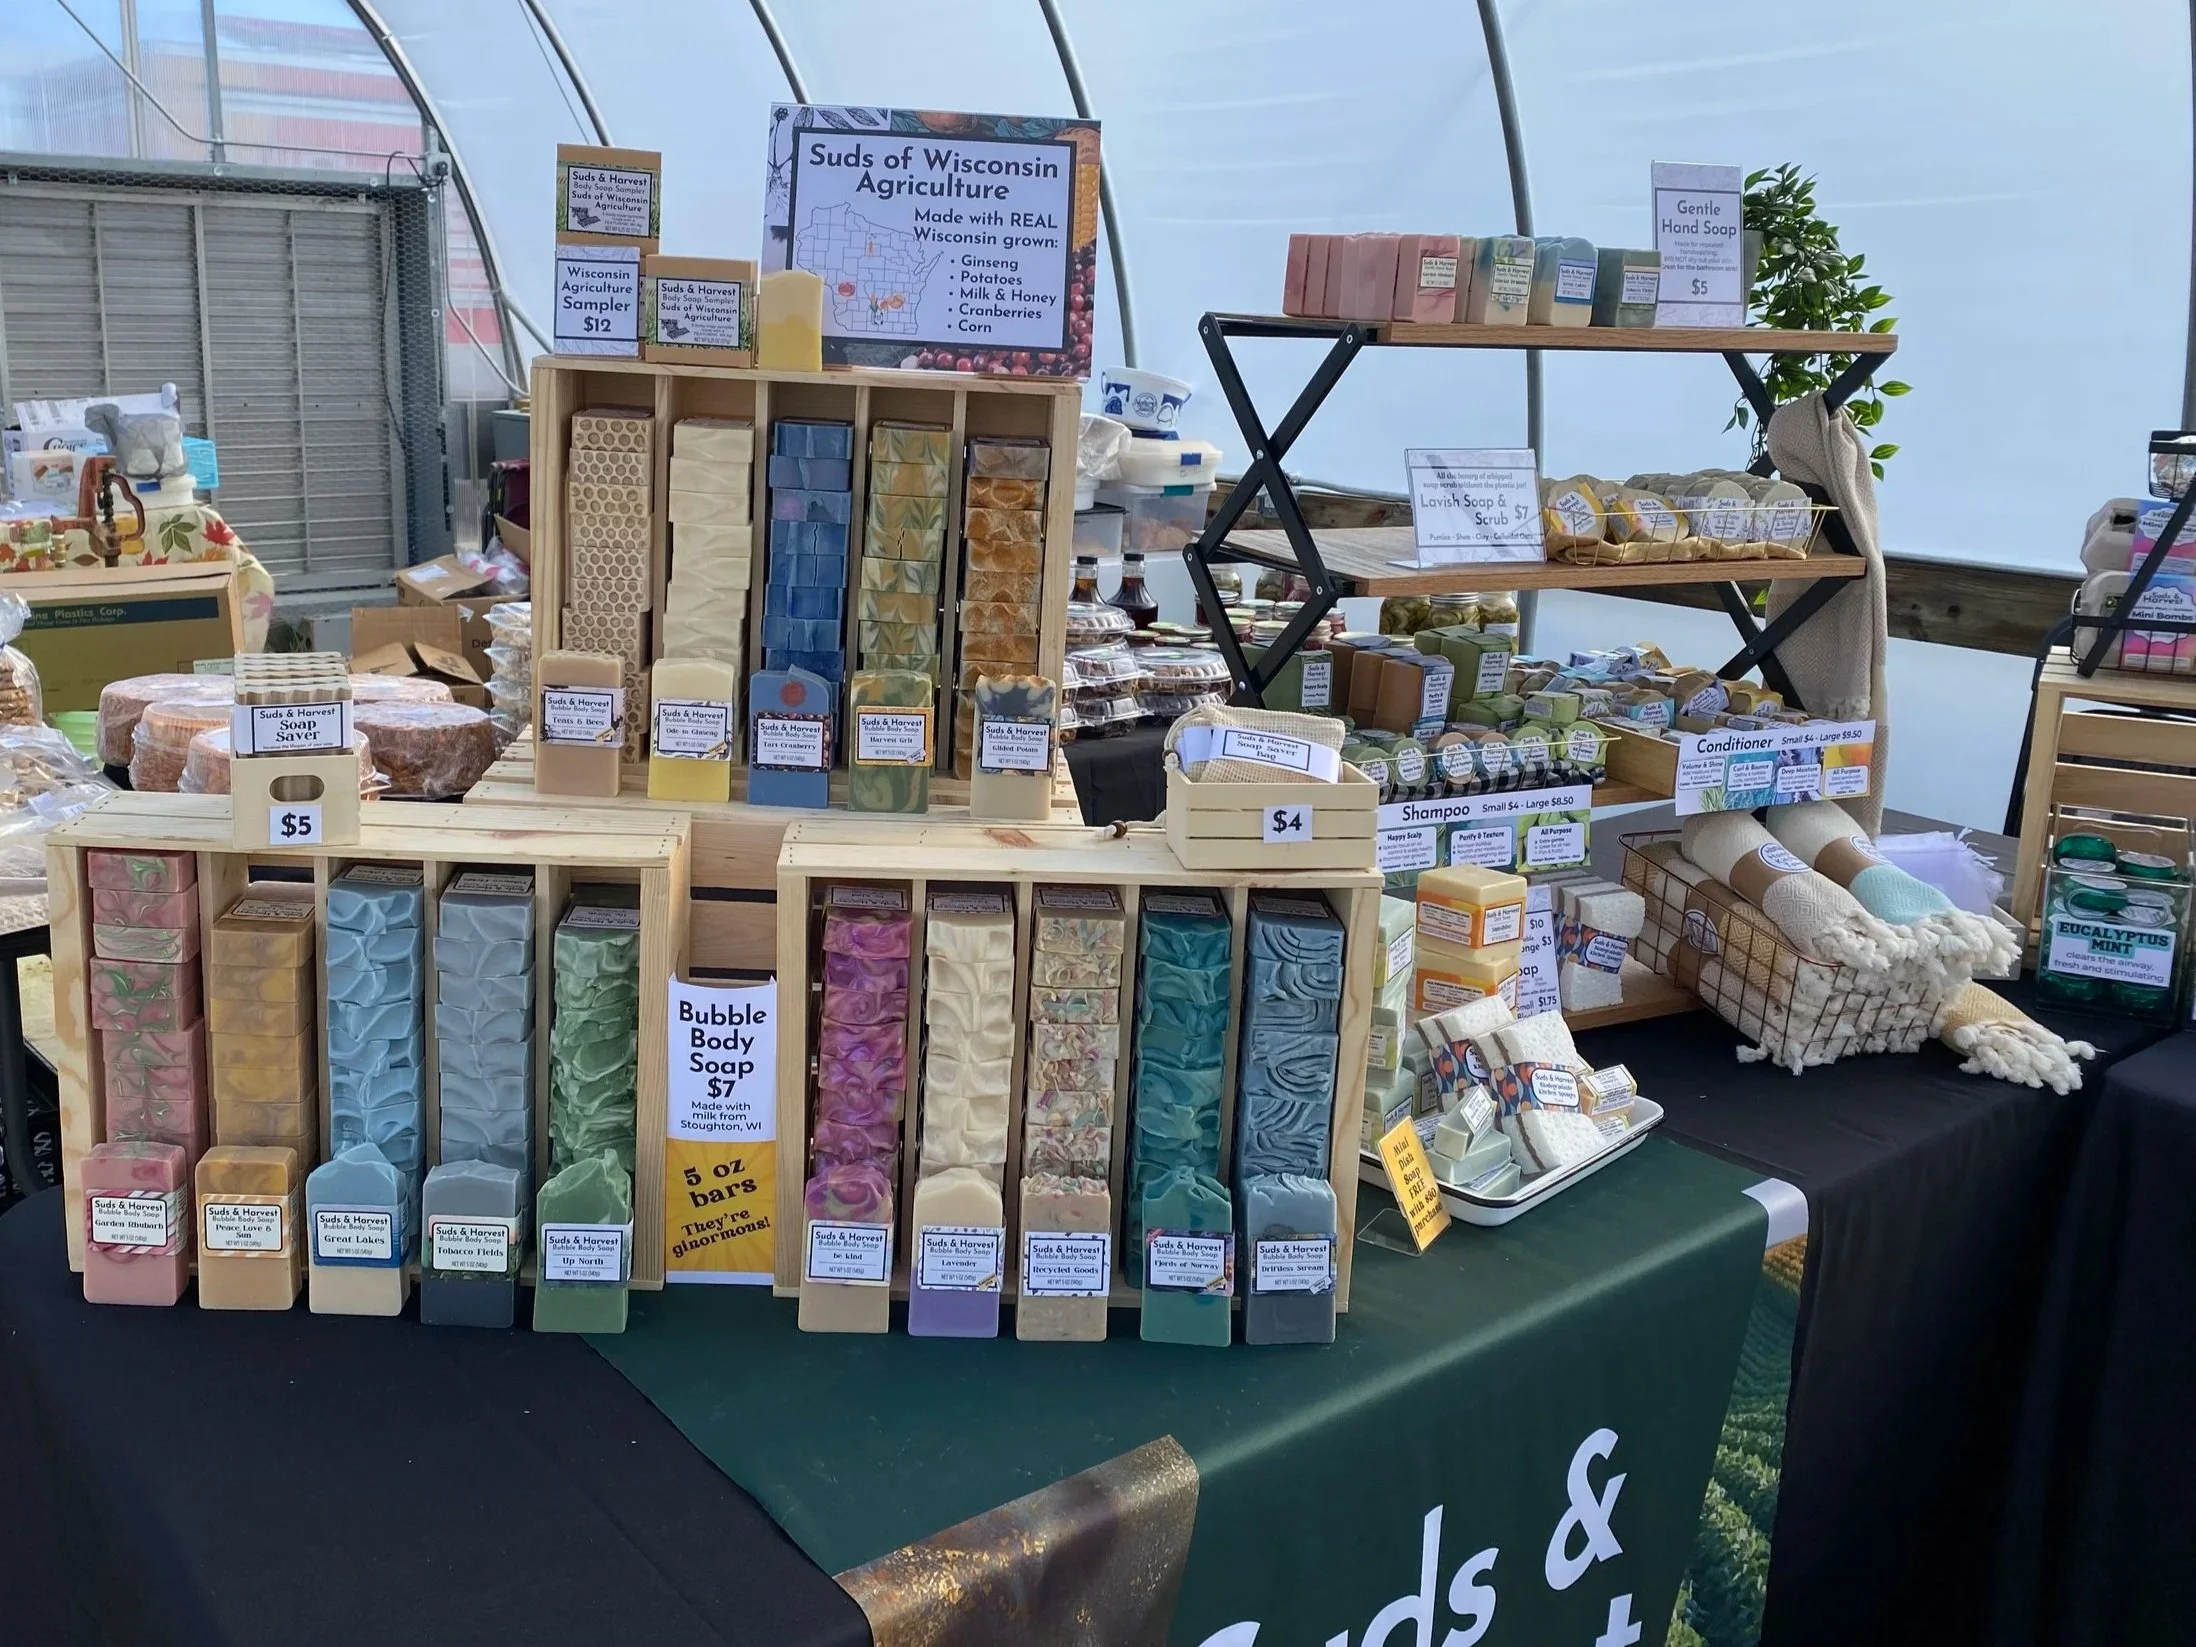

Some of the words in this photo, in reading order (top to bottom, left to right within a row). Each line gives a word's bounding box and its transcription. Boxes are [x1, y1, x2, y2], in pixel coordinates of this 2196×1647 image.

[810, 143, 874, 169] Suds
[885, 145, 914, 169] of
[924, 148, 1058, 179] Wisconsin
[573, 171, 595, 183] Suds
[598, 174, 606, 183] &
[610, 175, 648, 187] Harvest
[856, 169, 1010, 200] Agriculture
[572, 190, 592, 200] Suds
[595, 192, 604, 201] of
[607, 194, 648, 205] Wisconsin
[595, 201, 642, 212] Agriculture
[1677, 200, 1721, 216] Gentle
[914, 207, 964, 225] Made
[970, 210, 1004, 227] with
[1010, 212, 1058, 229] REAL
[1662, 219, 1698, 235] Hand
[1703, 220, 1737, 239] Soap
[914, 226, 997, 246] Wisconsin
[1003, 235, 1058, 250] grown:
[961, 255, 1019, 272] Ginseng
[567, 266, 630, 280] Wisconsin
[961, 271, 1022, 286] Potatoes
[562, 281, 632, 294] Agriculture
[661, 283, 684, 293] Suds
[687, 285, 695, 294] &
[699, 285, 736, 297] Harvest
[1691, 277, 1709, 296] $5
[563, 296, 630, 314] Sampler
[960, 287, 990, 300] Milk
[996, 289, 1006, 301] &
[1011, 291, 1057, 307] Honey
[661, 303, 680, 312] Suds
[684, 303, 693, 312] of
[696, 305, 737, 315] Wisconsin
[960, 303, 1042, 320] Cranberries
[584, 315, 611, 333] $12
[684, 313, 732, 325] Agriculture
[958, 320, 992, 333] Corn
[1420, 493, 1460, 508] Lavish
[1464, 494, 1494, 510] Soap
[1498, 494, 1507, 507] &
[1476, 511, 1509, 525] Scrub
[1514, 504, 1529, 521] $7
[55, 609, 94, 619] Plastics
[100, 607, 127, 617] Corp.
[2132, 610, 2154, 619] Mini
[2156, 612, 2193, 620] Bombs
[260, 710, 283, 719] Suds
[286, 709, 294, 717] &
[298, 707, 335, 717] Harvest
[552, 717, 573, 725] Teats
[280, 719, 316, 732] Soap
[691, 729, 718, 738] Ginseng
[275, 731, 320, 743] Saver
[1697, 736, 1773, 754] Conditioner
[1782, 735, 1803, 745] Small
[1804, 735, 1814, 744] $4
[1820, 732, 1842, 742] Large
[1842, 730, 1862, 740] $9.50
[781, 742, 817, 752] Cranberry
[992, 745, 1015, 753] Gilded
[1237, 740, 1262, 751] Soap
[1266, 745, 1298, 757] Saver
[1257, 751, 1277, 761] Bag
[1782, 767, 1794, 775] Deep
[1402, 804, 1470, 822] Shampoo
[1482, 802, 1507, 813] Small
[1507, 800, 1519, 811] $4
[1526, 800, 1550, 810] Large
[1551, 796, 1574, 806] $8.50
[281, 812, 312, 838] $5
[1273, 810, 1303, 833] $4
[1387, 833, 1408, 843] Happy
[1410, 831, 1422, 840] Scalp
[1459, 832, 1476, 841] Purify
[1483, 831, 1505, 839] Texture
[1541, 828, 1551, 836] All
[1552, 827, 1573, 836] Purpose
[1530, 919, 1544, 930] $10
[1542, 936, 1552, 946] $3
[2058, 922, 2169, 948] EUCALYPTUS
[2090, 938, 2134, 955] MINT
[2066, 951, 2096, 961] clears
[2098, 955, 2116, 965] the
[2120, 958, 2155, 972] airway,
[2054, 959, 2079, 970] fresh
[2082, 963, 2102, 974] and
[2104, 967, 2165, 984] stimulating
[1538, 995, 1557, 1007] $1.75
[679, 1001, 767, 1025] Bubble
[690, 1027, 755, 1054] Body
[689, 1052, 754, 1079] Soap
[707, 1076, 736, 1099] $7
[691, 1102, 723, 1111] Made
[725, 1102, 751, 1111] with
[692, 1111, 717, 1120] milk
[719, 1111, 747, 1120] from
[680, 1119, 743, 1132] Stoughton,
[745, 1121, 761, 1130] WI
[1393, 1136, 1410, 1157] Mini
[1398, 1152, 1415, 1171] Dish
[684, 1166, 702, 1186] 5
[712, 1158, 746, 1178] oz
[1403, 1167, 1420, 1185] Soap
[689, 1178, 758, 1208] bars
[1408, 1178, 1425, 1200] FREE
[1409, 1202, 1425, 1218] with
[95, 1219, 125, 1228] Garden
[128, 1221, 164, 1230] Rhubarb
[681, 1209, 750, 1238] They're
[1414, 1202, 1443, 1237] purchase
[324, 1235, 351, 1244] Great
[356, 1236, 385, 1245] Lakes
[672, 1216, 771, 1259] ginormous!
[437, 1247, 474, 1255] Tobacco
[477, 1248, 504, 1257] Fields
[563, 1257, 575, 1266] Up
[579, 1257, 604, 1266] North
[941, 1259, 978, 1268] Lavender
[1155, 1260, 1177, 1268] Fjords
[1191, 1262, 1219, 1270] Norway
[1297, 1264, 1324, 1272] Stream
[1033, 1266, 1070, 1275] Recycled
[1074, 1266, 1099, 1274] Goods
[1545, 1428, 1628, 1590] &
